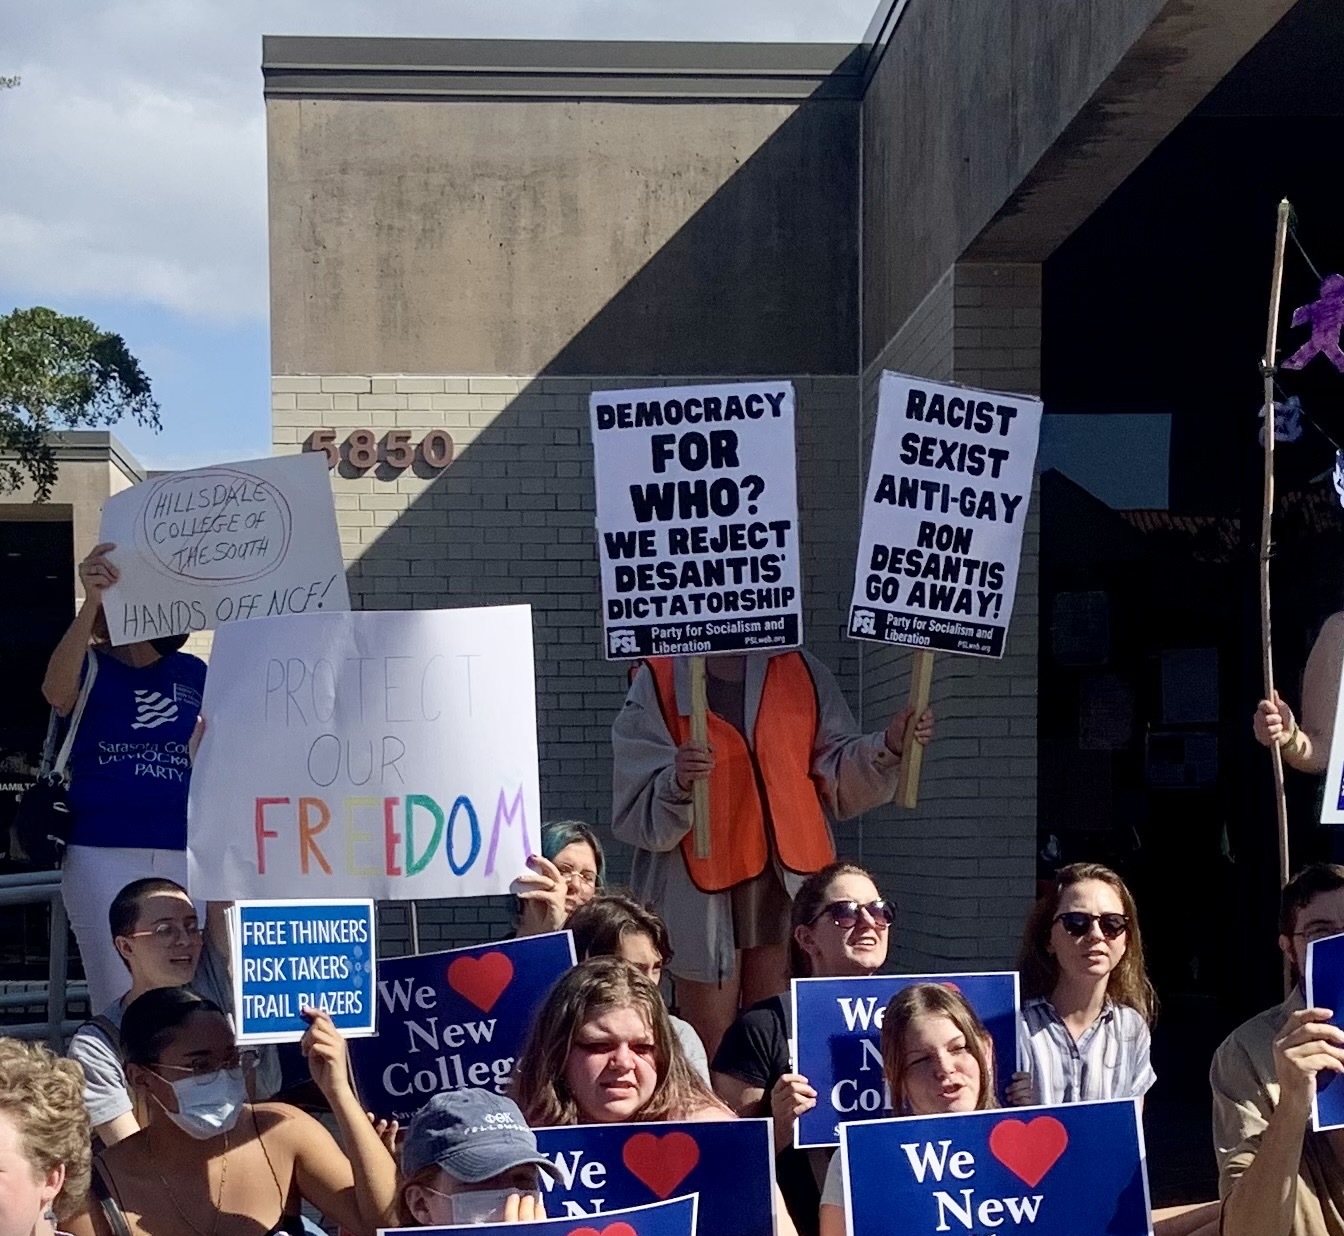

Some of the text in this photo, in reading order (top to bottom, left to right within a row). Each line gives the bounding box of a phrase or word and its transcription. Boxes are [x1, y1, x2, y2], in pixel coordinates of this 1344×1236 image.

[597, 391, 786, 430] DEMOCRACY
[905, 389, 1018, 438] RACIST
[309, 428, 455, 470] 5850
[650, 430, 740, 474] FOR
[899, 433, 1009, 478] SEXIST
[152, 482, 267, 520] HILLSDALE
[630, 475, 765, 523] WHO?
[874, 473, 1023, 524] ANTI-GAY
[152, 511, 267, 545] COLLEGE OF
[605, 520, 791, 560] WE REJECT
[916, 521, 973, 555] RON
[173, 536, 270, 571] THE SOUTH
[615, 554, 787, 592] DESANTIS'
[869, 545, 1006, 590] DESANTIS
[123, 574, 338, 638] HANDS OFF NCF!
[608, 586, 795, 621] DICTATORSHIP
[866, 573, 1003, 619] GO AWAY!
[651, 618, 785, 642] Party for Socialism and
[652, 639, 711, 653] Liberation
[265, 654, 481, 727] PROTECT
[135, 763, 184, 782] PARTY
[307, 733, 406, 788] OUR
[256, 783, 534, 879] FREEDOM
[243, 918, 368, 946] FREE THINKERS
[243, 955, 349, 983] RISK TAKERS
[243, 993, 295, 1019] TRAIL
